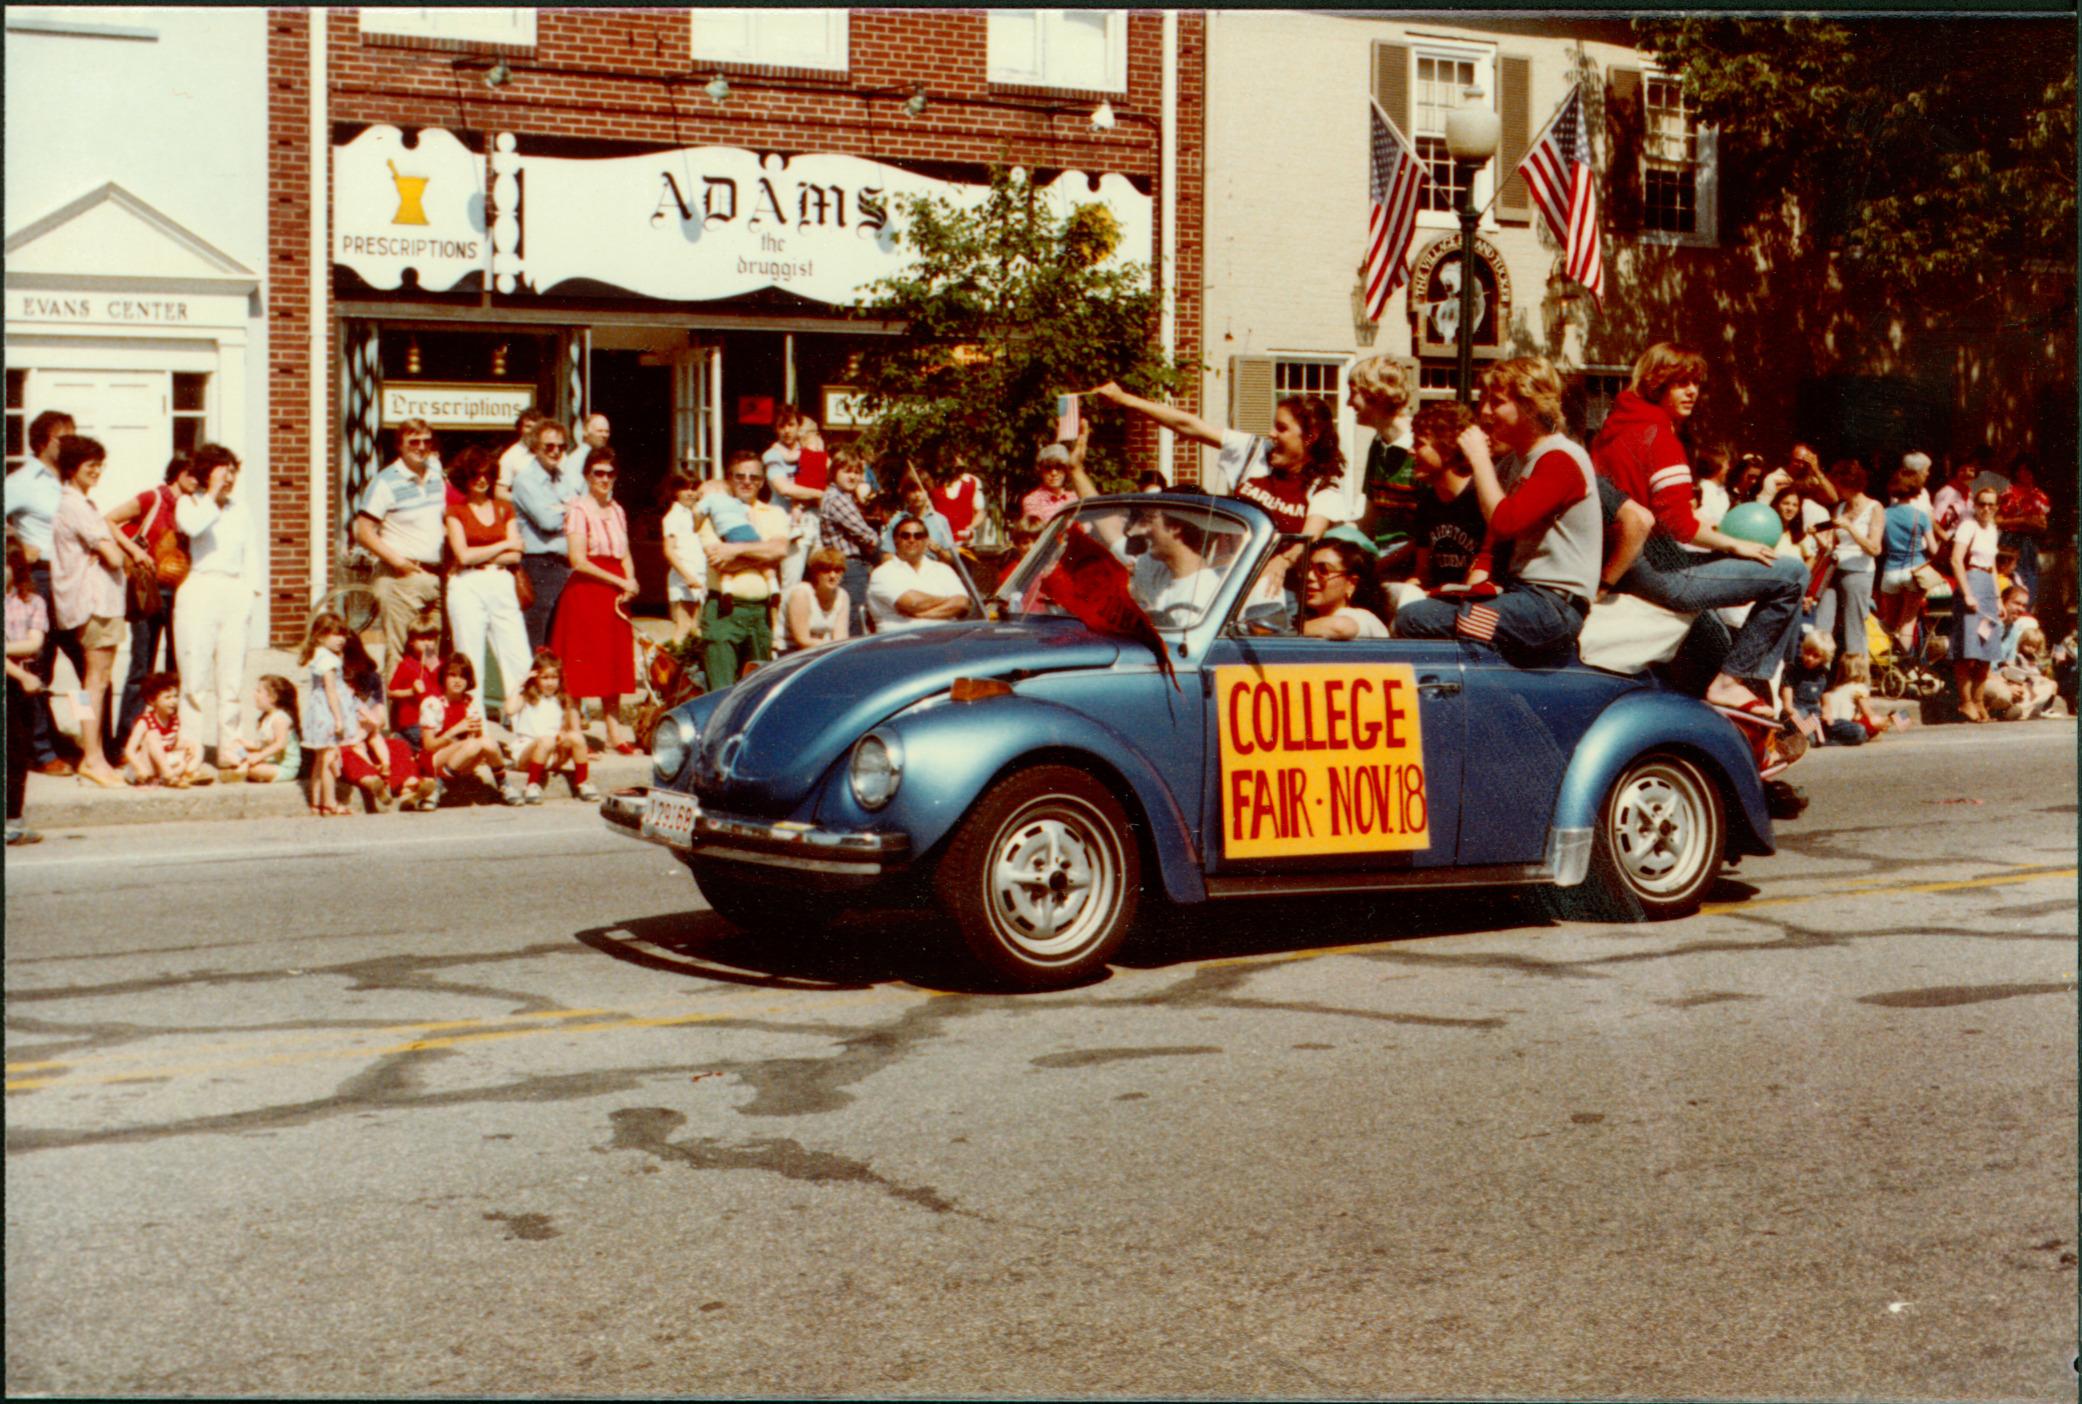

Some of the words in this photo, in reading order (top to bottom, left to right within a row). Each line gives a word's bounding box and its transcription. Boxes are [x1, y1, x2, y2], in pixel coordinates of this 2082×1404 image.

[651, 172, 888, 238] ADAMS
[342, 235, 478, 259] PRESCRIPTIONS
[761, 232, 786, 252] the
[737, 255, 814, 281] druggist
[23, 298, 91, 317] EVANS
[107, 301, 188, 320] CENTER
[392, 393, 522, 419] Prescriptions
[1229, 678, 1406, 755] COLLEGE
